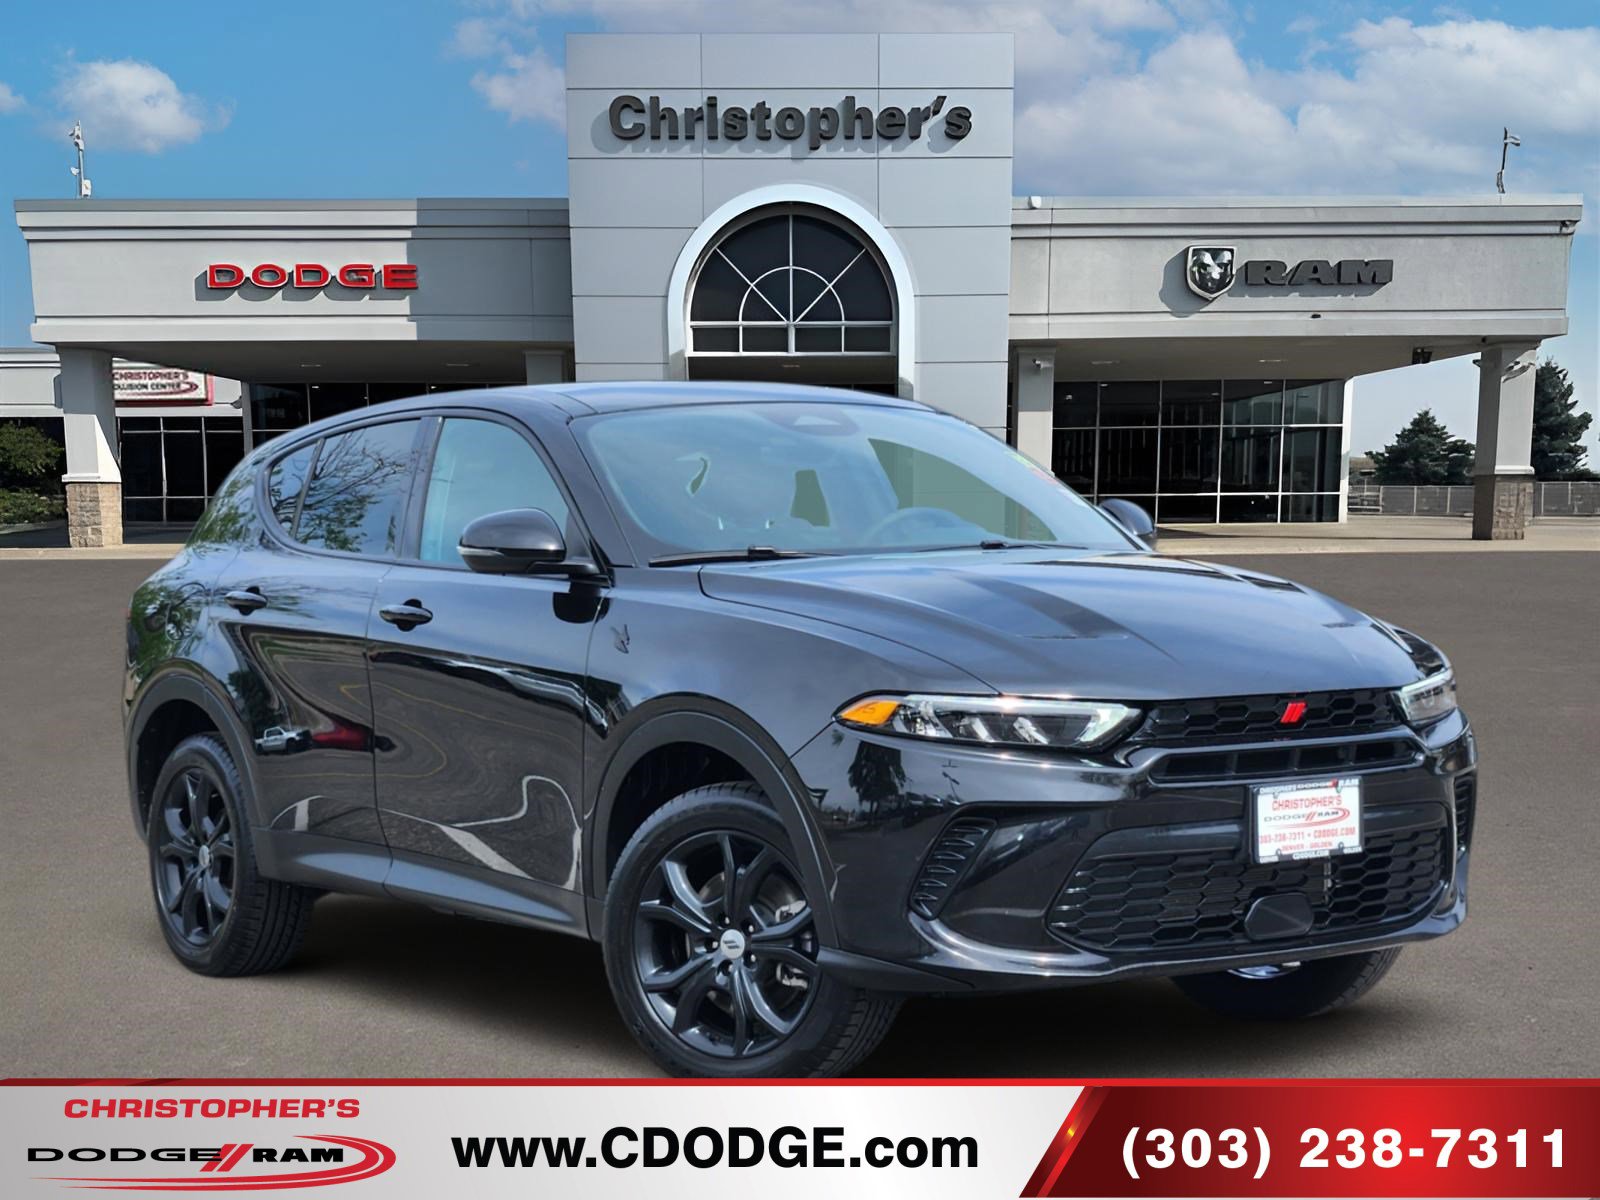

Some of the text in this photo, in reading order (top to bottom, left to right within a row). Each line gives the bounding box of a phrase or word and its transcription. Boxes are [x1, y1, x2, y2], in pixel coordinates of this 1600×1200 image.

[609, 95, 972, 150] Christopher's
[207, 263, 418, 289] DODGE
[1245, 259, 1394, 286] RAM
[112, 371, 189, 381] CHRISTOPHER'S
[112, 382, 182, 391] OLLISION CENTER
[1272, 795, 1342, 811] CHRISTOPHER'S
